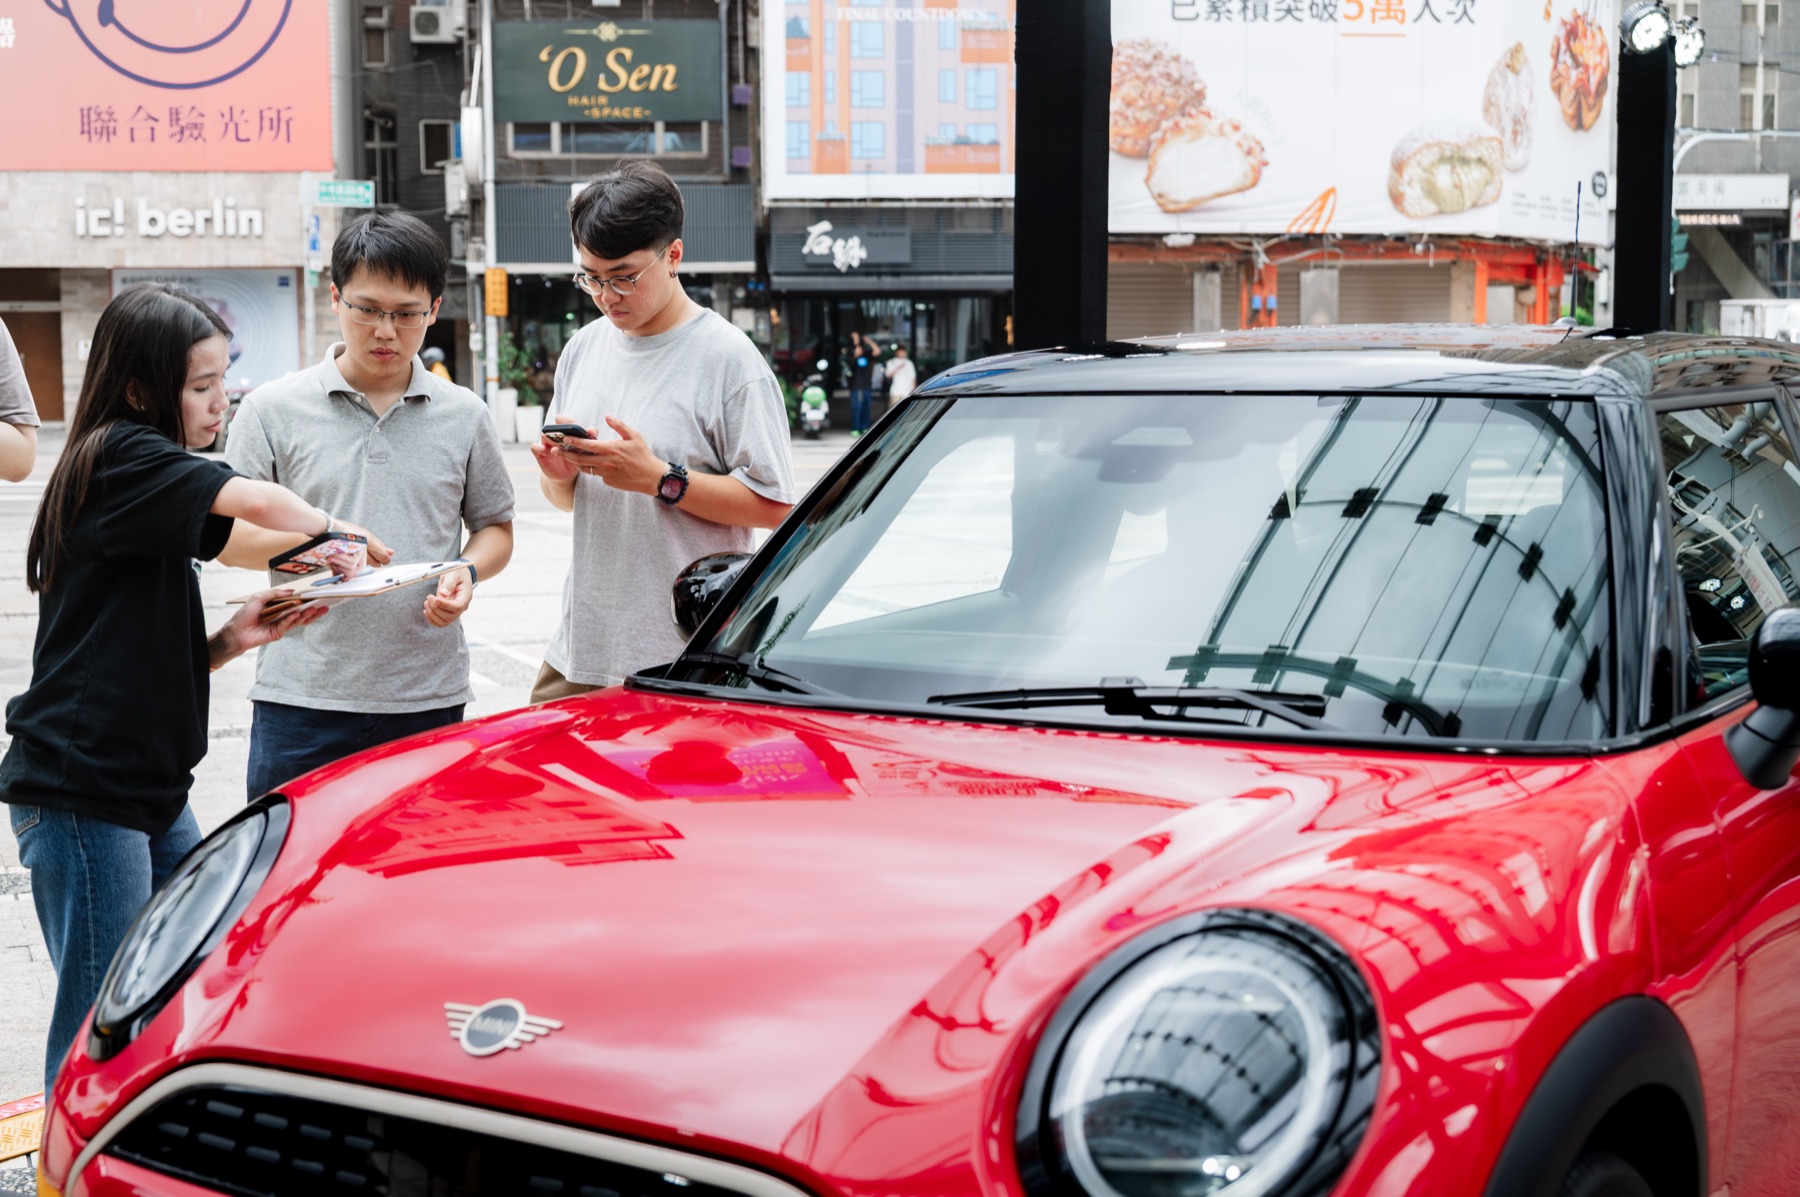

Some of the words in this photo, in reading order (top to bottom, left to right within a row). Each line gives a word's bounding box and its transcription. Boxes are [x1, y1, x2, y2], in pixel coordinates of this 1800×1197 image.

[837, 7, 880, 21] FINAL
[884, 7, 989, 21] COUNTDOWN
[597, 46, 678, 93] Sen
[567, 95, 609, 107] HAIR
[79, 105, 294, 144] 聯合驗光所
[74, 196, 126, 238] ic!
[137, 196, 264, 238] berlin
[470, 1015, 516, 1036] MINI
